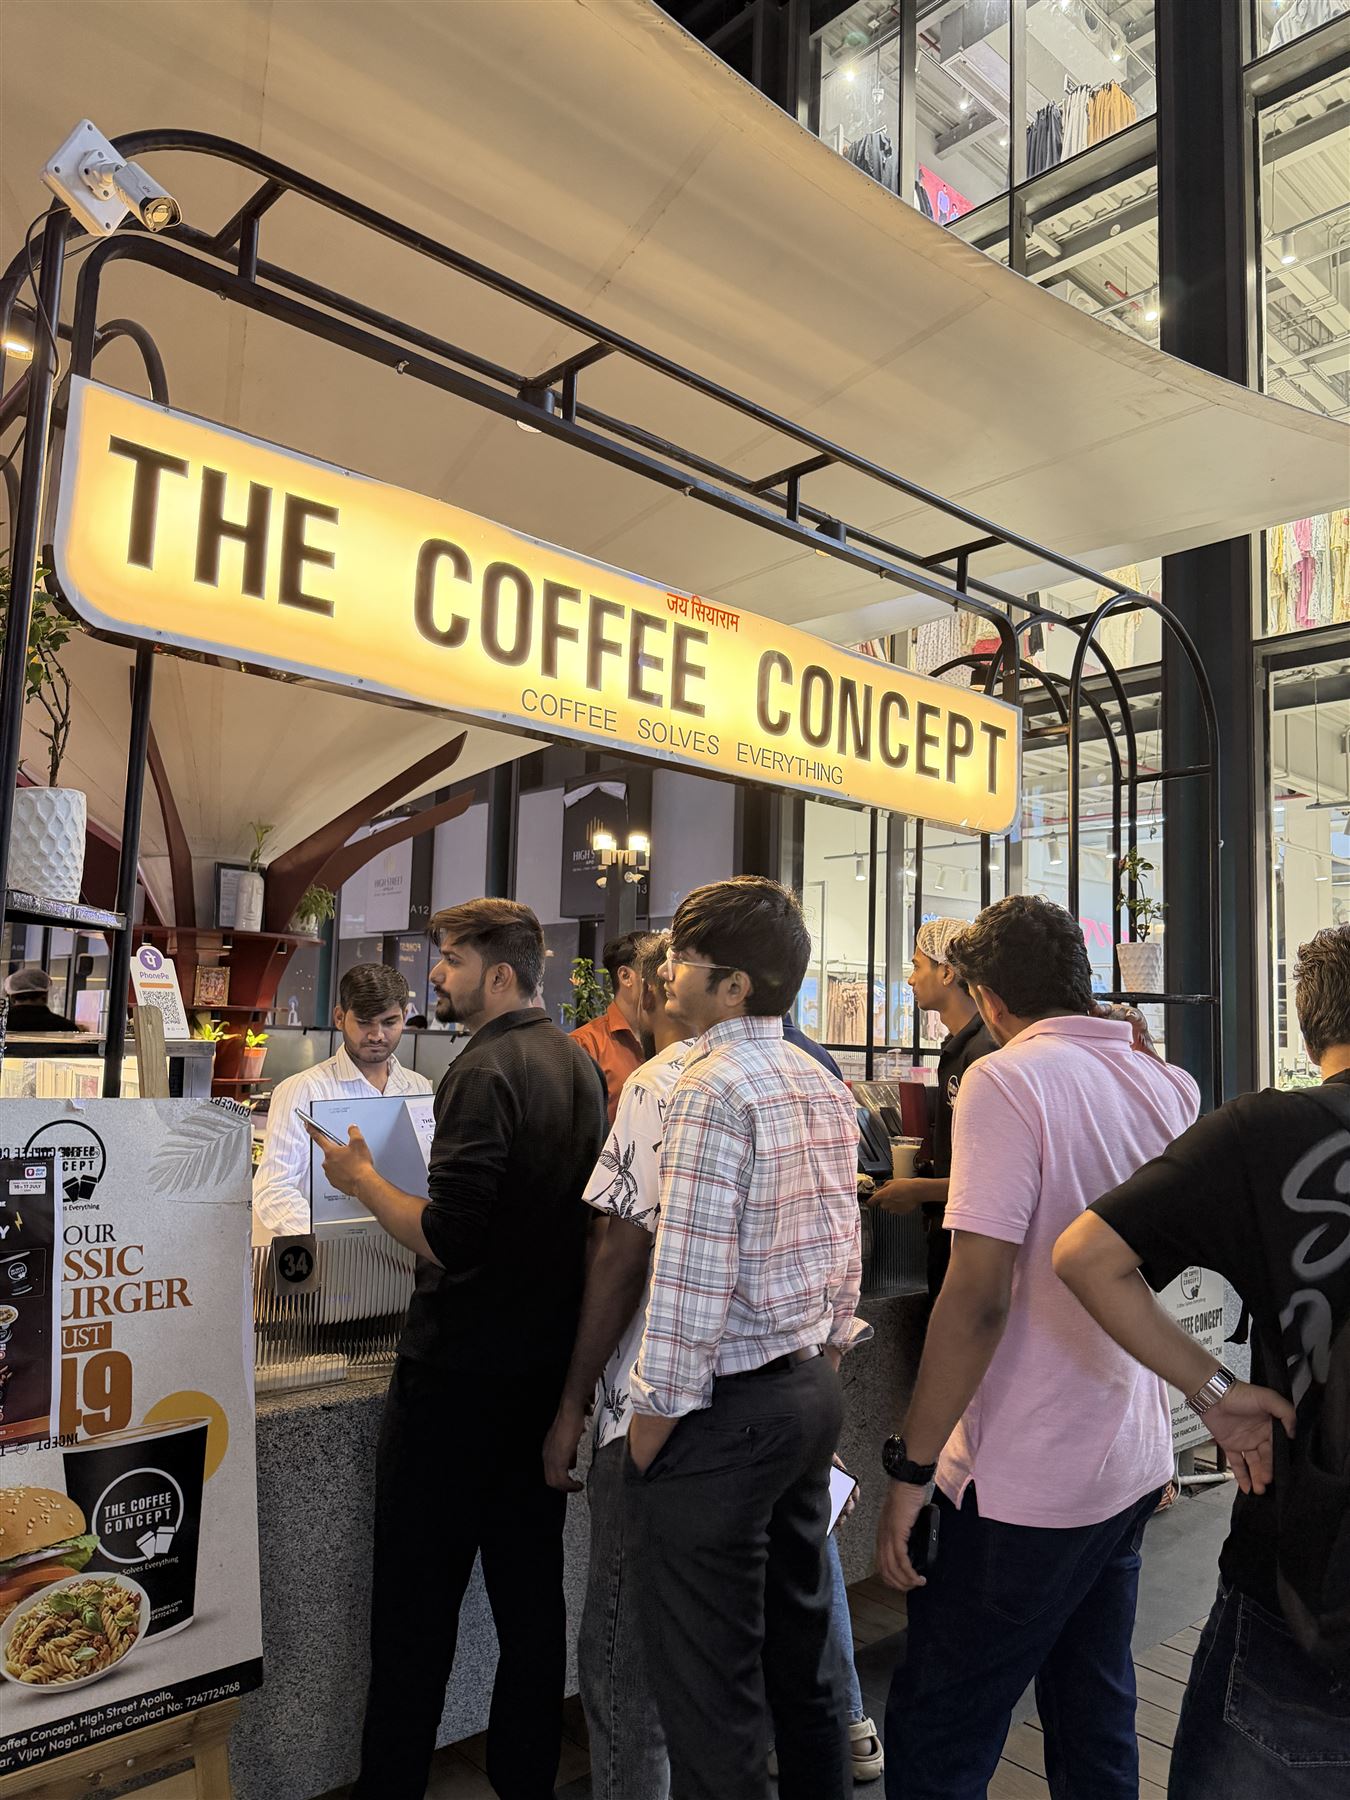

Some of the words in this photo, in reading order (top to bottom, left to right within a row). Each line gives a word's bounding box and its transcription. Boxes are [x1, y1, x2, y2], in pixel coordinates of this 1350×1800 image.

[109, 435, 339, 617] THE
[414, 538, 709, 718] COFFEE
[757, 650, 1006, 794] CONCEPT
[666, 592, 690, 617] जय
[691, 594, 740, 632] सियाराम
[521, 689, 617, 732] COFFEE
[638, 718, 720, 755] SOLVES
[737, 742, 843, 785] EVERYTHING
[139, 971, 170, 980] PhonePe
[210, 1097, 250, 1118] CONCEPT
[62, 1160, 95, 1171] CEPT
[69, 1203, 100, 1211] Everything
[63, 1223, 117, 1246] OUR
[62, 1244, 144, 1283] SSIC
[284, 1252, 308, 1277] 34
[61, 1277, 193, 1321] URGER
[1194, 1307, 1223, 1333] CONCEPT
[62, 1325, 105, 1349] UST
[104, 1502, 126, 1518] THE
[130, 1491, 172, 1512] COFFEE
[104, 1508, 172, 1535] CONCEPT
[144, 1556, 179, 1570] Everything
[0, 1737, 28, 1753] offee
[30, 1720, 77, 1743] Concept,
[80, 1711, 105, 1728] High
[106, 1700, 138, 1719] Street
[139, 1691, 174, 1709] Apollo,
[18, 1745, 46, 1762] Vijay
[49, 1732, 87, 1752] Nagar,
[90, 1721, 123, 1739] Indore
[124, 1706, 166, 1727] Contact
[166, 1701, 183, 1714] No:
[185, 1681, 240, 1707] 7247724768
